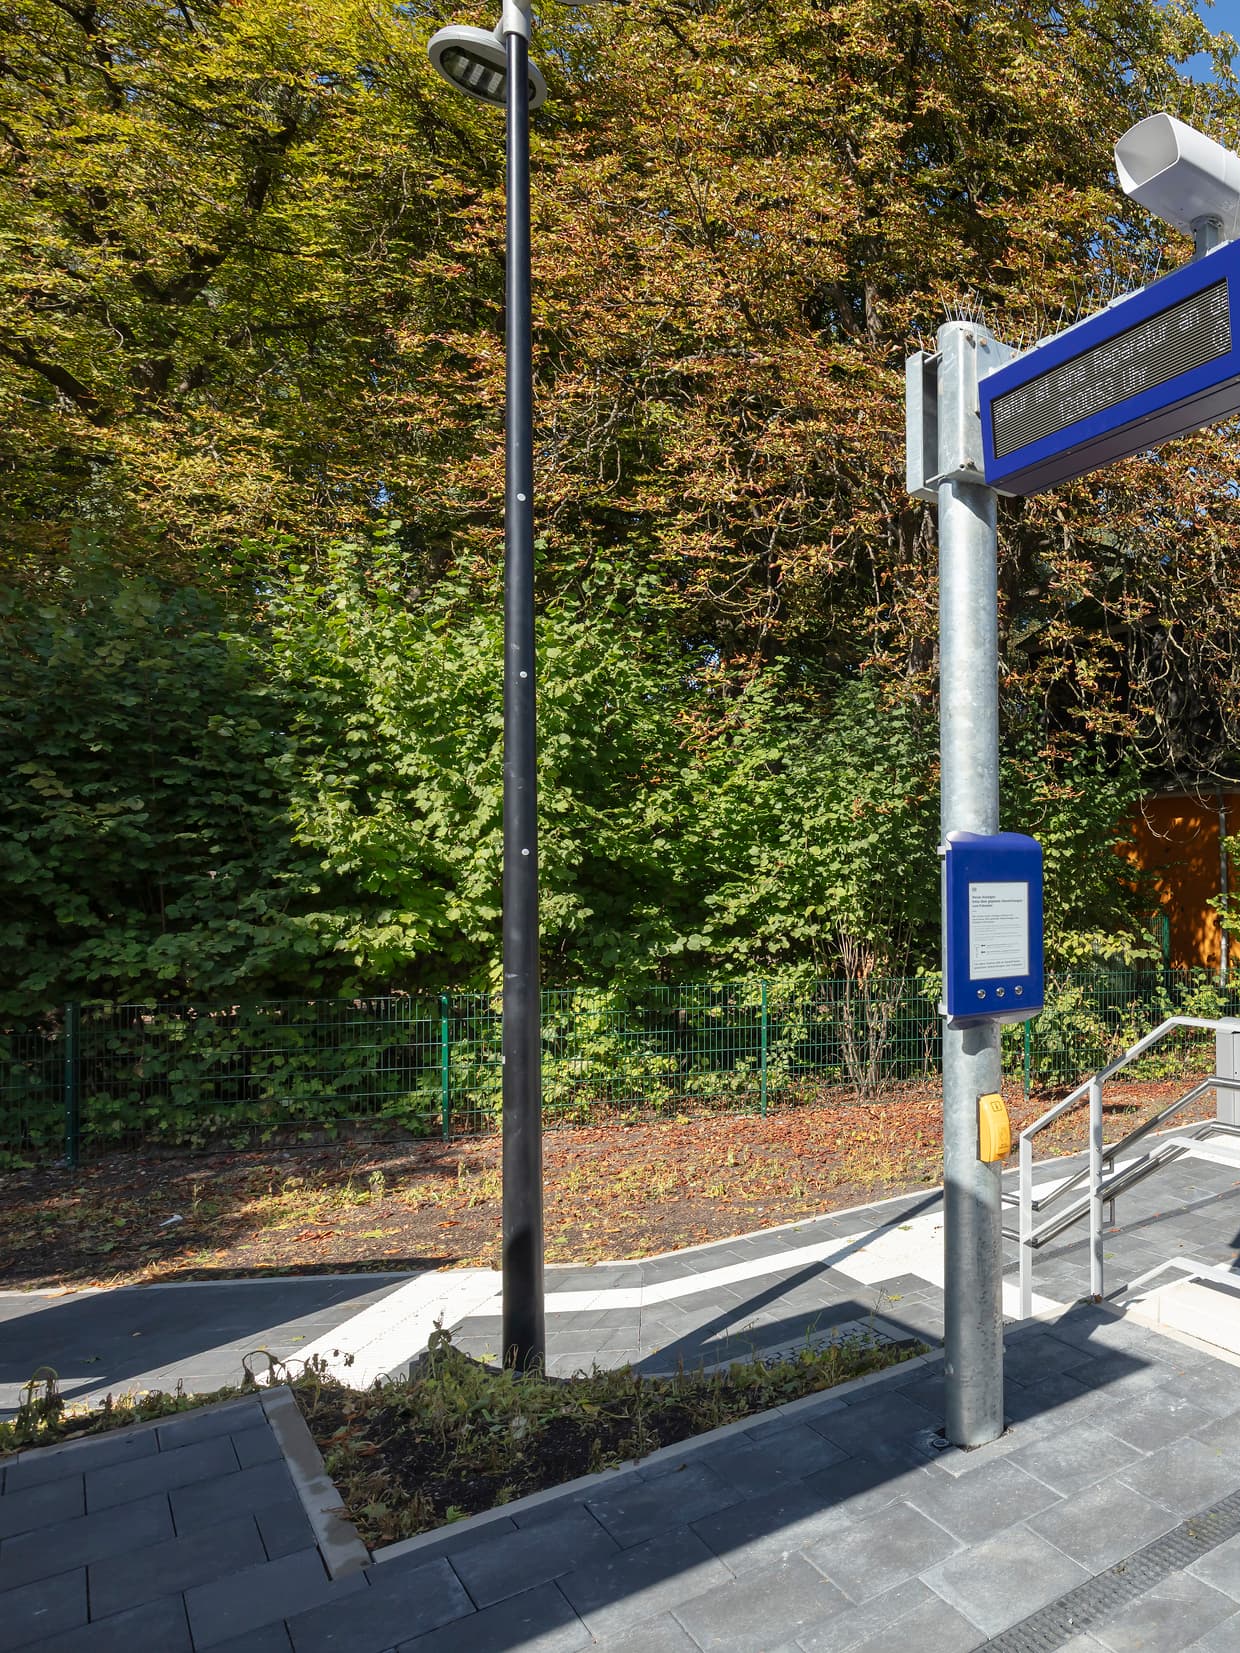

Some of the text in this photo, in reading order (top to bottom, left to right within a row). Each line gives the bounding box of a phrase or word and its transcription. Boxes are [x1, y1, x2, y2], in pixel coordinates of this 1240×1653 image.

[995, 390, 1027, 422] dafür
[1035, 378, 1049, 402] ist
[1057, 364, 1085, 391] eine
[1093, 321, 1168, 373] Reparatur
[1178, 308, 1198, 331] an
[1058, 363, 1147, 421] 12:00:53 Uhr
